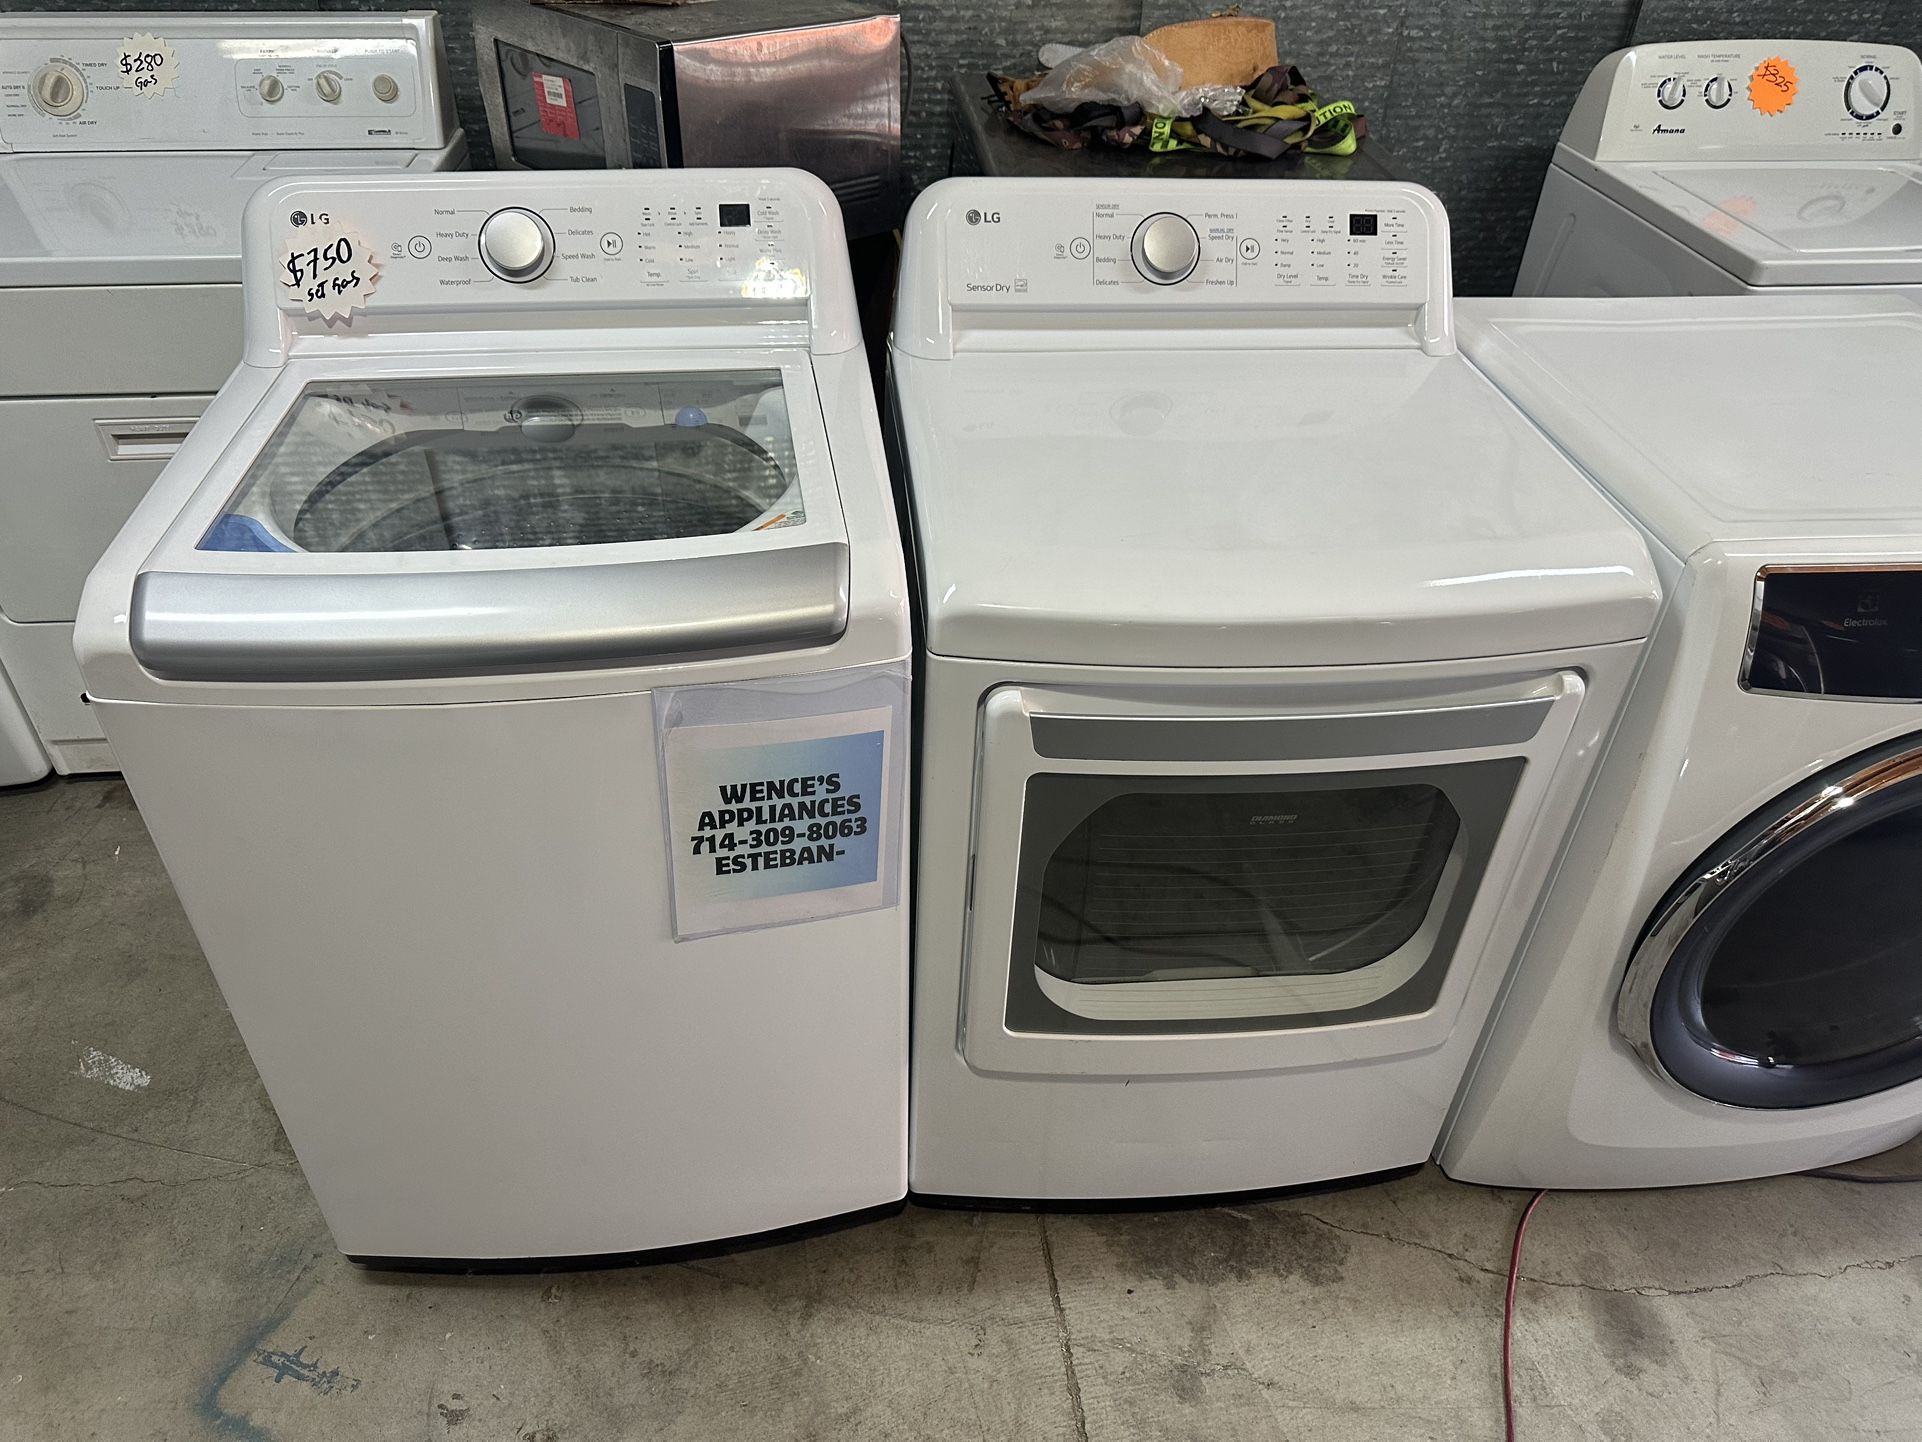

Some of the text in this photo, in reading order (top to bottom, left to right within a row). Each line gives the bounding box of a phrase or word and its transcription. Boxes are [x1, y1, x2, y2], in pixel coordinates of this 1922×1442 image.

[1757, 62, 1793, 93] $325
[1652, 124, 1685, 135] Amana
[569, 206, 593, 214] Bedding
[984, 212, 1000, 223] LG
[436, 231, 469, 239] Heavy Duty
[287, 237, 352, 288] $750
[437, 255, 453, 263] Deep
[561, 253, 579, 261] Speed
[1227, 279, 1234, 287] Up
[1843, 618, 1888, 627] Electrolux
[719, 773, 841, 805] WENCE'S
[697, 794, 862, 832] APPLIANCES
[690, 816, 867, 855] 714-309-8063
[715, 843, 846, 876] ESTEBAN-
